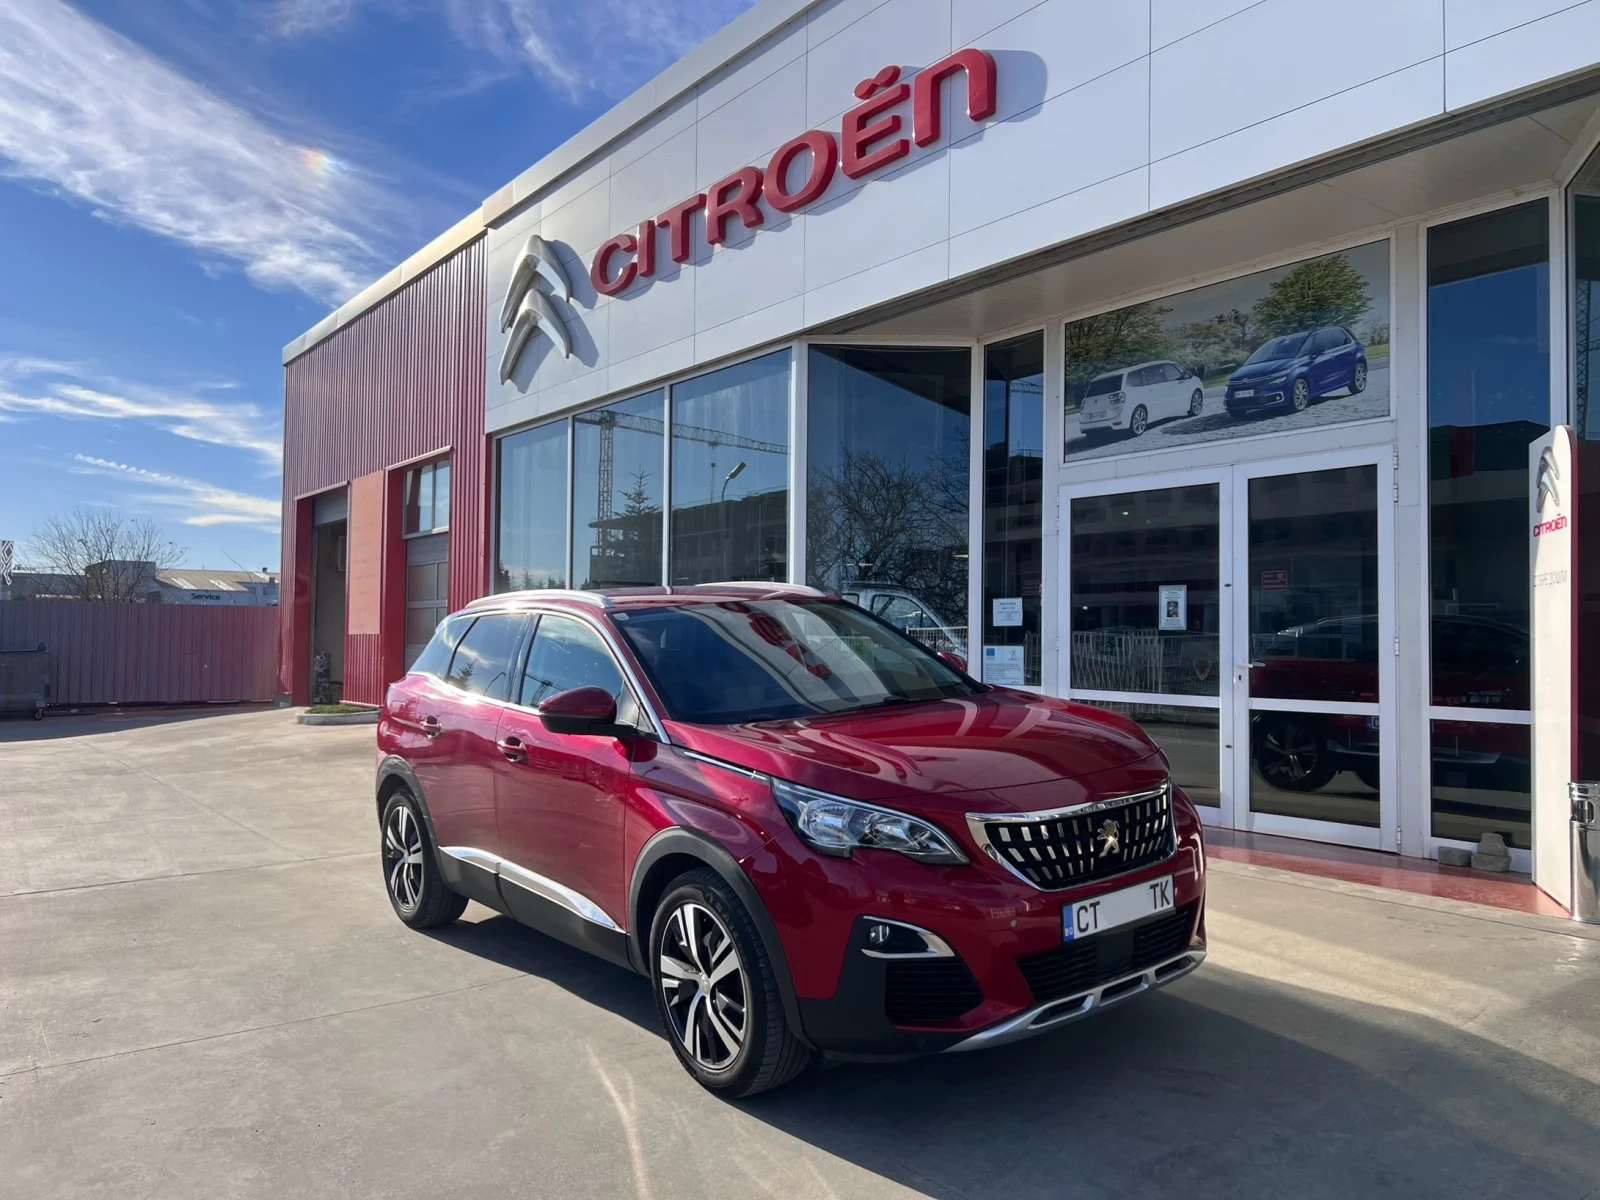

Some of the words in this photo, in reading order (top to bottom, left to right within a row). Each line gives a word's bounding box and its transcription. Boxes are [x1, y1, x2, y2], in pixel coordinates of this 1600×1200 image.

[590, 48, 997, 296] CITROËN
[1533, 513, 1567, 537] CITROËN
[190, 592, 221, 600] Service
[1064, 926, 1074, 937] BG
[1077, 901, 1101, 933] CT
[1149, 879, 1171, 910] TK
